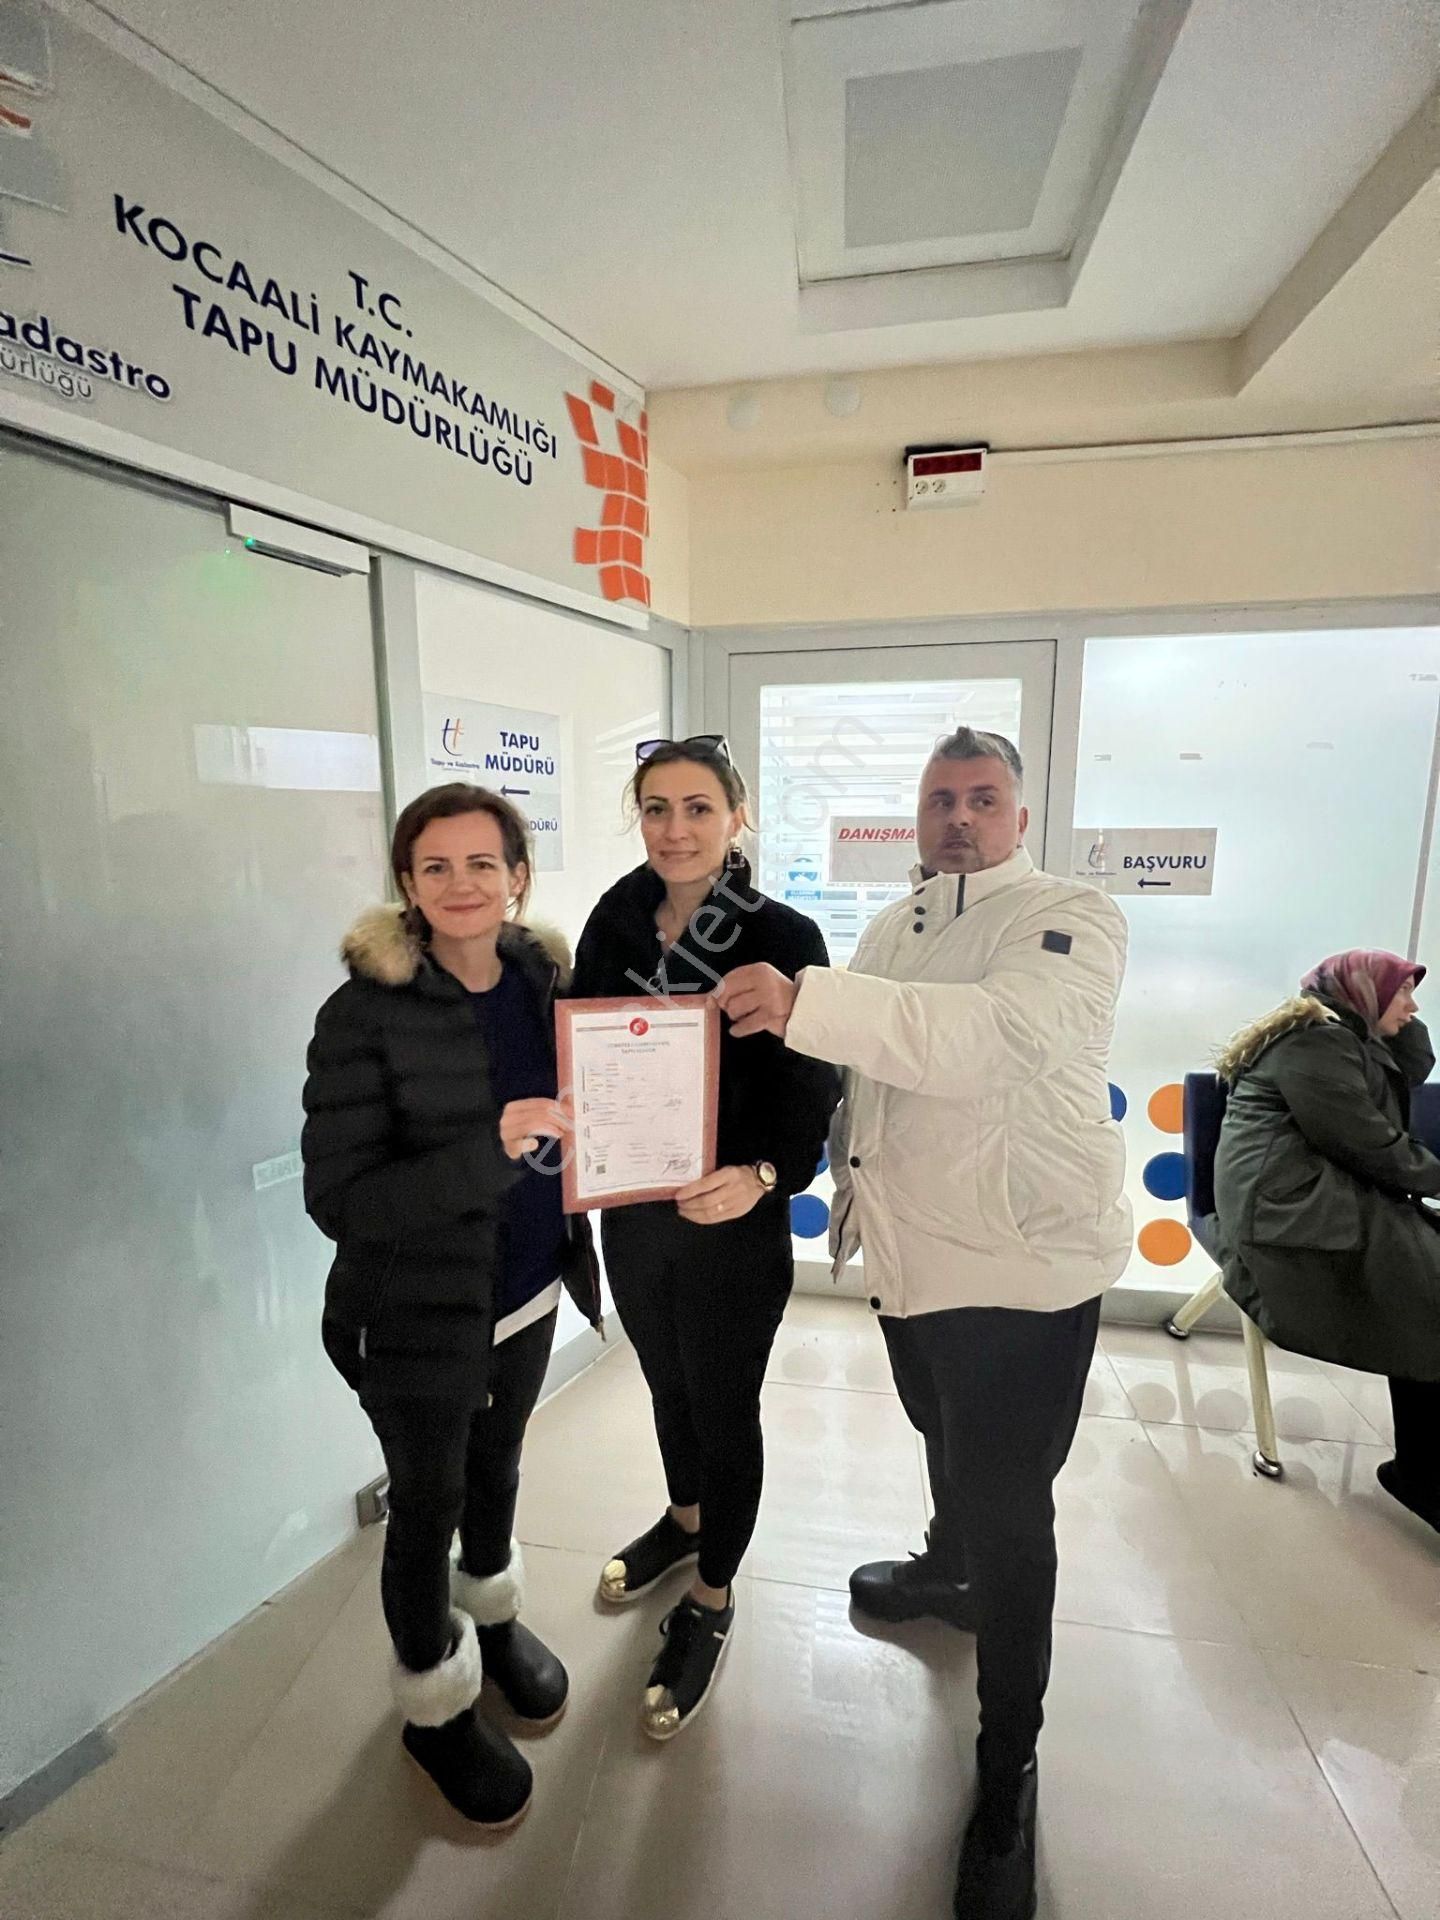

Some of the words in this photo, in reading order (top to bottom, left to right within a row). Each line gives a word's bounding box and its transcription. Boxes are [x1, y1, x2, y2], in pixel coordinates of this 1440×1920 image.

[348, 270, 413, 338] T.C.
[113, 193, 320, 336] KOCAALİ
[334, 315, 559, 460] KAYMAKAMLIĞI
[0, 311, 171, 399] adastro
[0, 346, 92, 398] ürlüğü
[172, 283, 298, 376] TAPU
[314, 354, 533, 486] MÜDÜRLÜĞÜ
[499, 731, 540, 752] TAPU
[485, 751, 555, 776] MÜDÜRÜ
[529, 817, 558, 832] DÜRÜ
[838, 828, 916, 842] DANIŞMA
[1123, 855, 1207, 873] BAŞVURU
